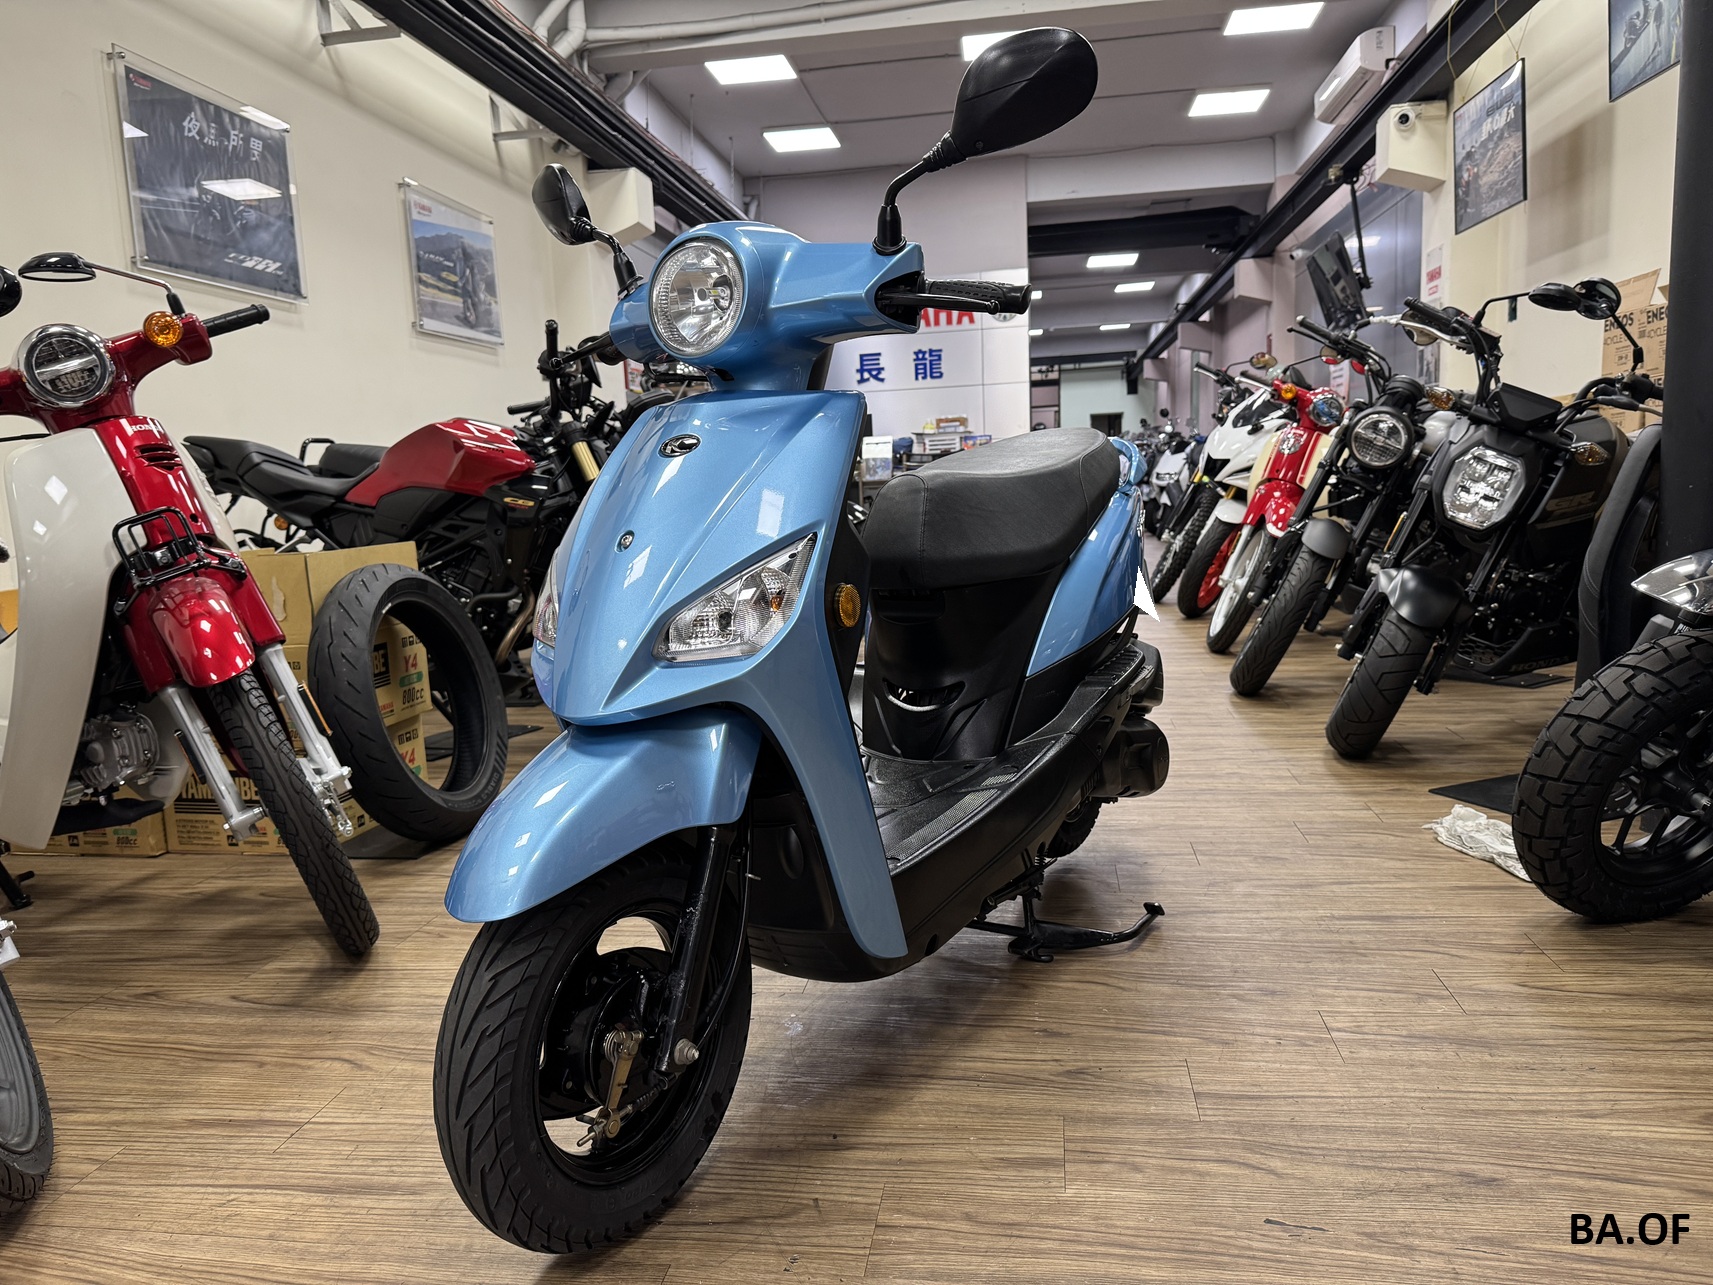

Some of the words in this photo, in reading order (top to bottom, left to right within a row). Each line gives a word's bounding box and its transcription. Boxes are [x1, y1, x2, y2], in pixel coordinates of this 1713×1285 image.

[921, 308, 975, 328] AHA
[856, 348, 944, 385] 長龍
[403, 653, 418, 673] Y4
[402, 686, 424, 705] 800cc
